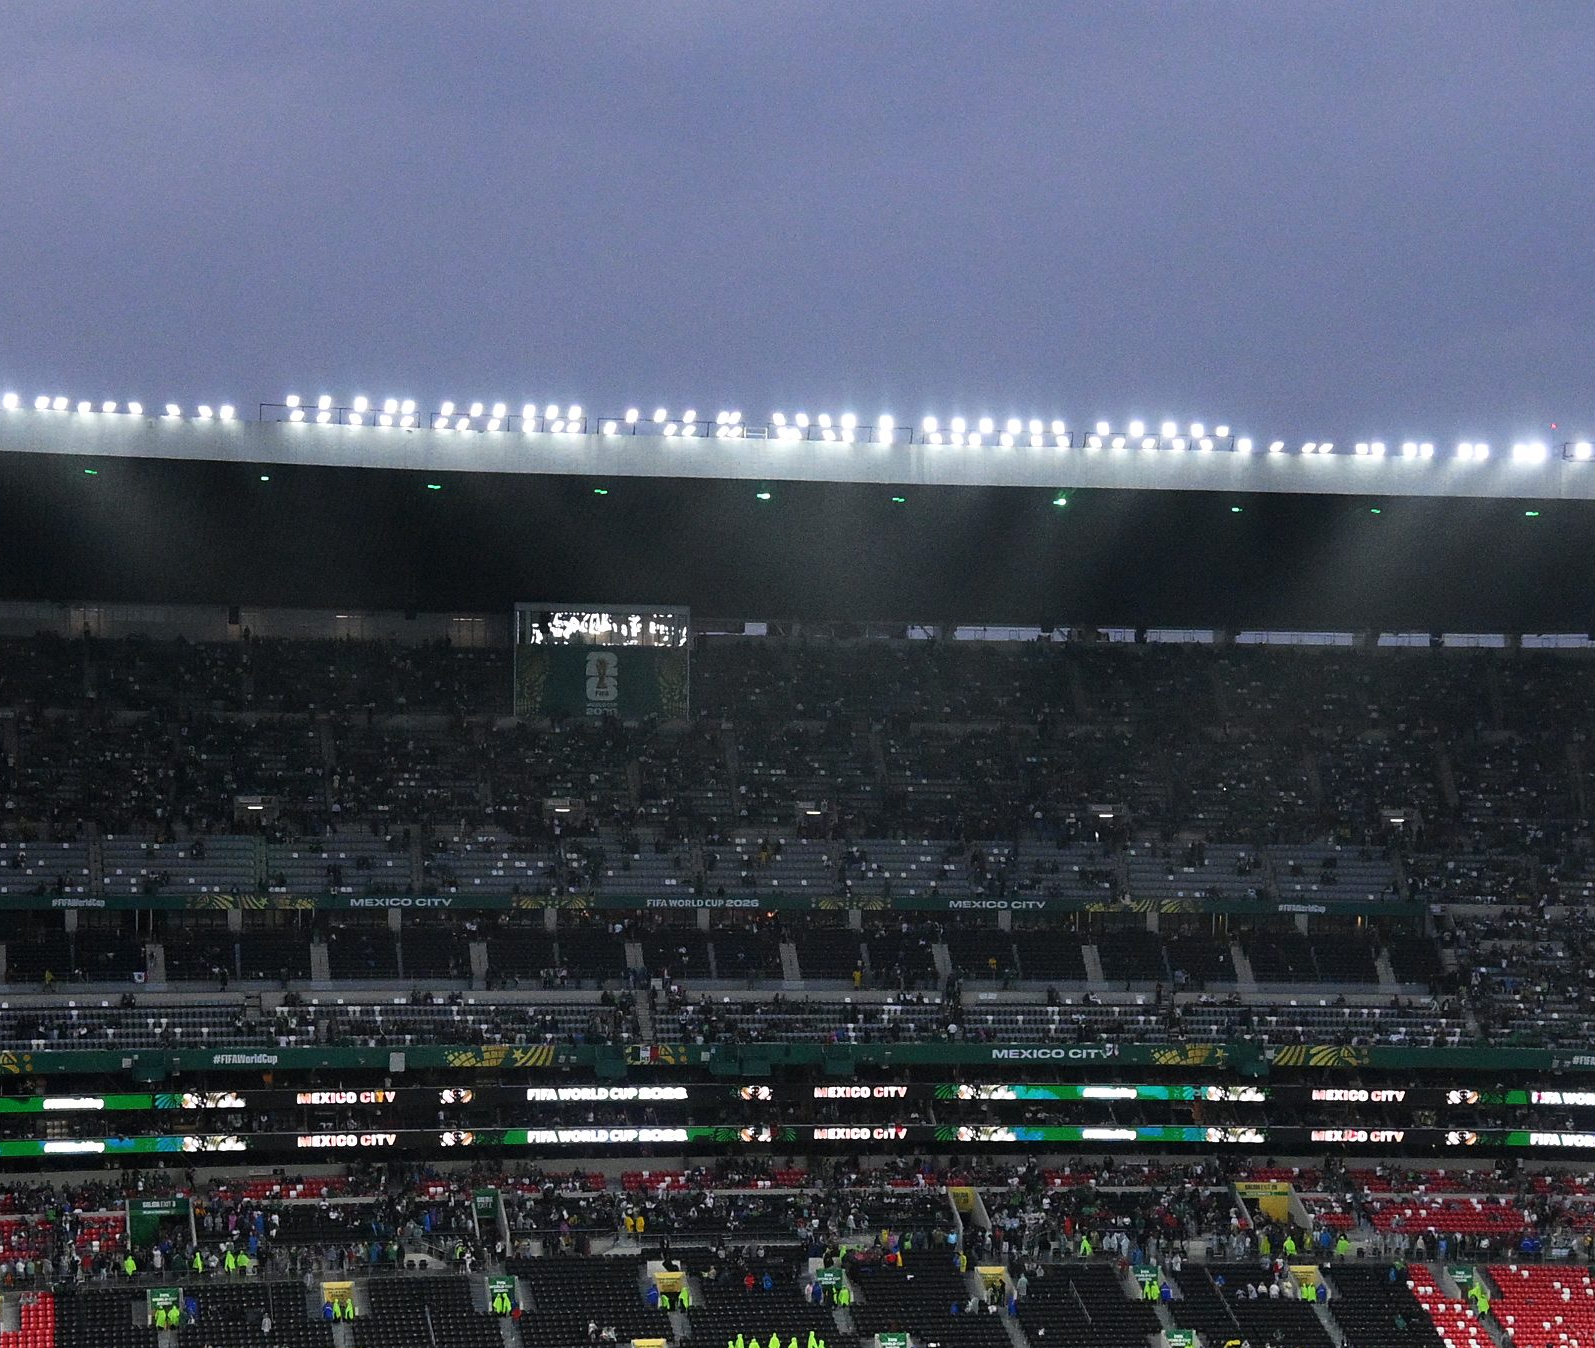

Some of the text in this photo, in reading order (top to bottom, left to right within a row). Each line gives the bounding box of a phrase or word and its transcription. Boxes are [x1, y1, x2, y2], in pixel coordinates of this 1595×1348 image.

[350, 898, 453, 907] MEXICO CITY
[646, 899, 759, 908] FIFA WORLD CUP 2026
[949, 900, 1046, 909] MEXICO CITY
[213, 1054, 278, 1065] #FIFAWorldCup
[992, 1049, 1065, 1059] MEXICO
[297, 1091, 396, 1104] MEXICO CITY
[527, 1087, 557, 1100] FIFA
[557, 1087, 608, 1100] WORLD
[609, 1087, 638, 1100] CUP
[814, 1087, 907, 1099] MEXICO CITY
[1312, 1089, 1405, 1102] MEXICO CITY
[527, 1130, 557, 1142] FIFA
[557, 1129, 608, 1142] WORLD
[609, 1129, 638, 1142] CUP
[814, 1128, 869, 1140] MEXICO
[1311, 1130, 1404, 1143] MEXICO CITY
[1530, 1133, 1562, 1147] FIFA
[297, 1134, 396, 1147] MEXICO CITY
